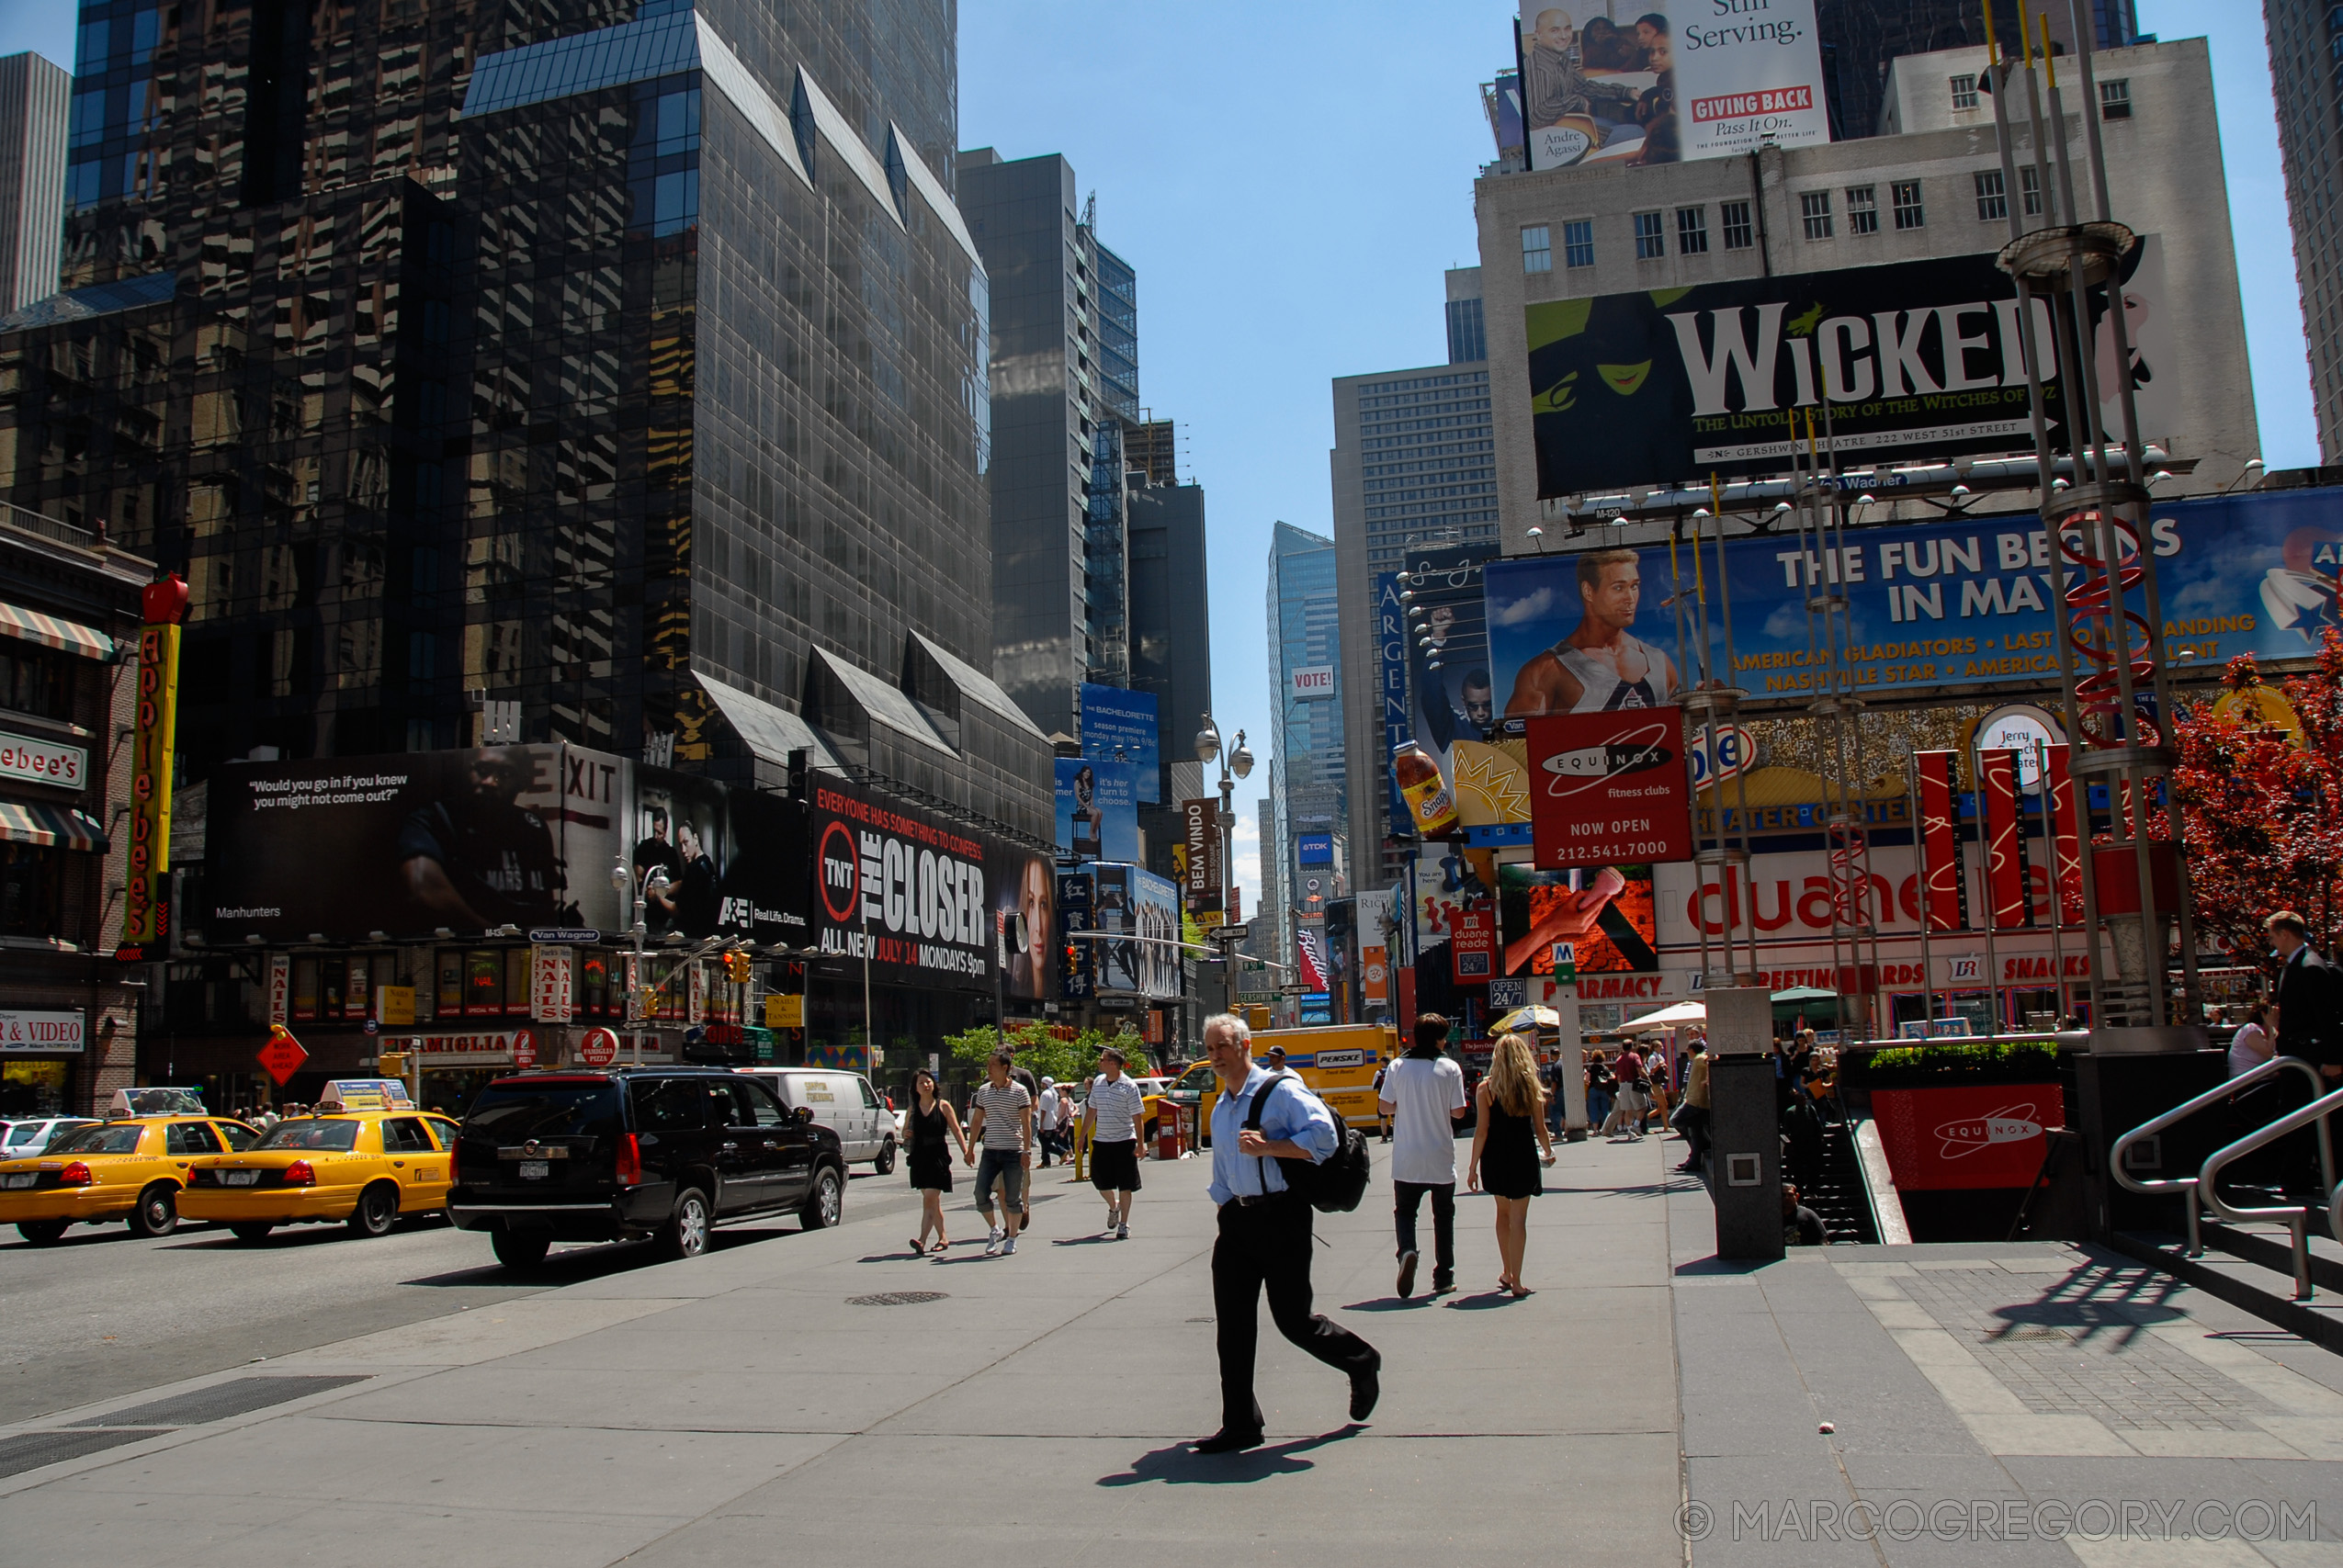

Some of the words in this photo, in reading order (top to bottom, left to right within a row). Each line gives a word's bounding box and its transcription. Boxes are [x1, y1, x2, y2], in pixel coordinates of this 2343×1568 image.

[1685, 17, 1804, 51] Serving.
[1695, 95, 1759, 119] GIVING
[1761, 88, 1809, 111] BACK
[1715, 121, 1745, 136] Pass
[1749, 118, 1760, 132] It
[1544, 130, 1580, 145] Andre
[1711, 137, 1753, 148] FOUNDATION
[1545, 141, 1581, 157] Agassi
[1692, 415, 1727, 433] THE
[1729, 409, 1801, 429] UNTOLD
[1806, 402, 1858, 423] STORY
[1862, 402, 1882, 418] OF
[1885, 398, 1919, 414] THE
[1921, 389, 2000, 412] WITCHES
[2003, 388, 2026, 402] OF
[1737, 442, 1804, 457] GERSHWIN
[1875, 434, 1898, 445] 222
[1903, 429, 1937, 440] WEST
[1942, 426, 1965, 438] 51st
[1970, 422, 2018, 434] STREET
[1596, 507, 1621, 519] M-120
[1776, 546, 1865, 588] THE
[1879, 536, 1982, 580] FUN
[1887, 581, 1945, 623] IN
[1732, 648, 1831, 671] AMERICAN
[1844, 636, 1977, 663] GLADIATORS
[2004, 631, 2054, 651] LAST
[1380, 583, 1408, 745] ARGENT
[1885, 663, 1937, 683] STAR
[1294, 671, 1332, 687] VOTE!
[1095, 705, 1155, 722] BACHELORETTE
[1083, 730, 1110, 742] monday
[1110, 734, 1126, 745] may
[1126, 735, 1140, 745] 19th
[1093, 721, 1117, 731] season
[1118, 725, 1147, 736] premiere
[2001, 730, 2030, 744] Jerry
[1556, 751, 1660, 770] EQUINOX
[290, 780, 313, 795] you
[313, 780, 329, 794] go
[330, 776, 341, 789] in
[343, 776, 352, 789] if
[353, 777, 375, 792] you
[375, 773, 408, 786] knew
[1113, 777, 1129, 787] her
[1947, 759, 1958, 809] PLAZA
[1099, 787, 1118, 796] turn
[1119, 787, 1129, 796] to
[1608, 787, 1643, 799] fitness
[1644, 784, 1670, 796] clubs
[254, 798, 277, 811] you
[277, 795, 311, 810] might
[312, 793, 331, 806] not
[332, 794, 365, 804] come
[1097, 796, 1132, 806] choose.
[817, 787, 870, 822] EVERYONE
[870, 807, 890, 829] HAS
[889, 814, 938, 846] SOMETHING
[938, 830, 949, 850] TO
[2012, 766, 2027, 856] BROADWAY
[1187, 805, 1205, 852] VINDO
[1570, 821, 1604, 837] NOW
[1611, 818, 1651, 834] OPEN
[1556, 840, 1668, 861] 212.541.7000
[486, 869, 545, 892] MARSAL
[824, 857, 855, 889] TNT
[860, 829, 883, 925] THE
[1191, 854, 1205, 889] BEM
[1952, 823, 1968, 922] PARAMOUNT
[883, 837, 986, 947] CLOSER
[215, 904, 281, 919] Manhunters
[718, 896, 750, 929] A&E
[754, 908, 769, 920] Real
[769, 909, 783, 922] Life.
[783, 911, 806, 927] Drama.
[536, 931, 555, 939] Van
[557, 931, 597, 941] Wagner
[1232, 928, 1244, 936] WAY
[1454, 929, 1490, 940] duane
[1455, 937, 1489, 949] reade
[820, 927, 846, 953] ALL
[847, 931, 877, 960] NEW
[877, 936, 904, 964] JULY
[904, 941, 918, 965] 14
[919, 943, 968, 972] MONDAYS
[968, 953, 986, 979] 9pm
[1462, 953, 1485, 964] OPEN
[1243, 962, 1250, 970] W
[1250, 961, 1258, 970] 50
[1462, 961, 1486, 972] 24/7
[540, 958, 558, 1019] NAILS
[560, 958, 572, 1019] NAILS
[1492, 980, 1523, 992] OPEN
[1543, 976, 1663, 1001] PARMACY
[1742, 968, 1839, 991] REETIN
[272, 967, 288, 1023] NAILS
[773, 997, 796, 1006] NAILS
[1239, 993, 1273, 1002] GERSHWIN
[1492, 992, 1523, 1007] 24/7
[767, 1012, 801, 1021] TANNING
[9, 1021, 22, 1042] &
[28, 1021, 81, 1042] VIDEO
[583, 1047, 614, 1055] FAMIGLIA
[589, 1055, 608, 1063] PIZZA
[1319, 1054, 1362, 1064] PENSKE
[1948, 1123, 2031, 1137] EQUINOX
